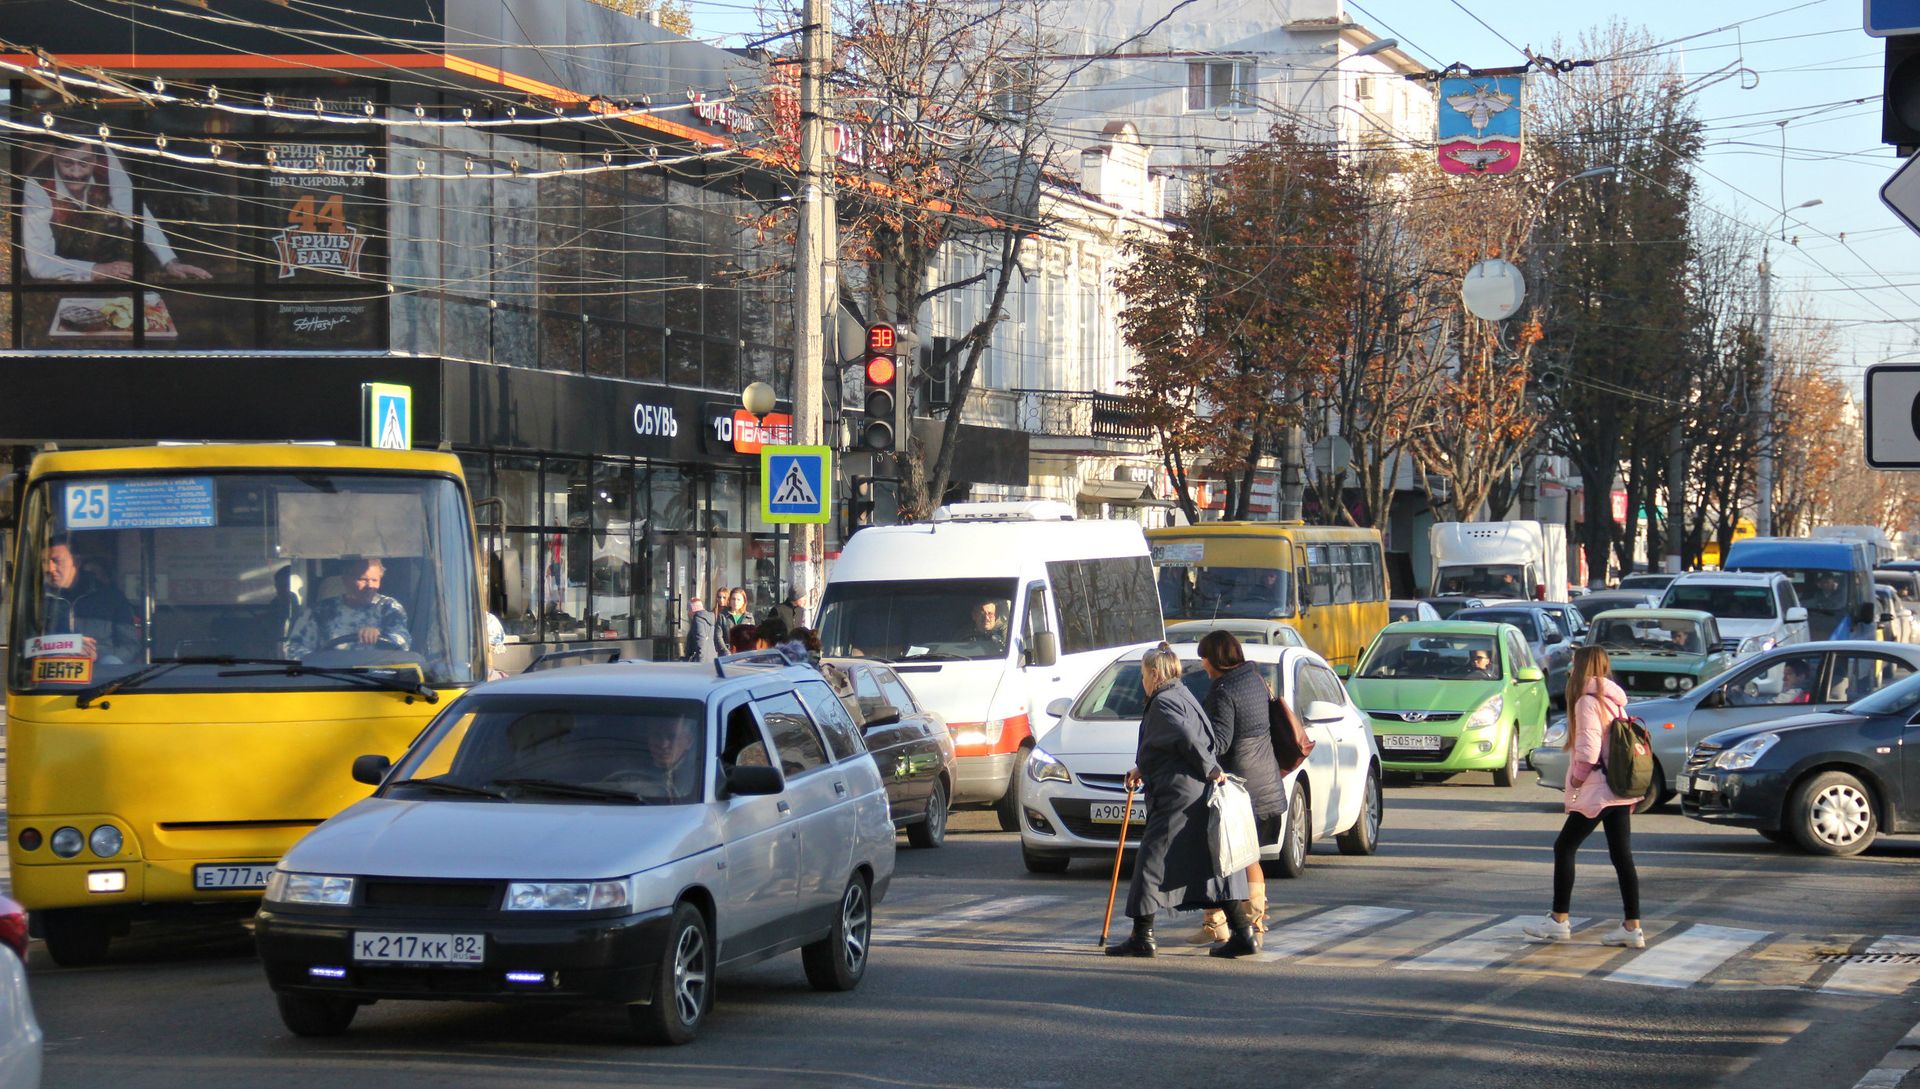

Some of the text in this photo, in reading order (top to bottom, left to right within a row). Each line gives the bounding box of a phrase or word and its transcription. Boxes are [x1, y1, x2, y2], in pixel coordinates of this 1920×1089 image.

[269, 145, 365, 158] ГРИЛЬ-БАР
[269, 160, 365, 173] ОТКРЫЛСЯ
[270, 177, 365, 189] ПР-Т КИРОВА, 24
[288, 195, 345, 233] 44
[291, 236, 349, 249] ГРИЛЬ
[297, 252, 342, 264] БАРА
[872, 329, 892, 346] 38
[634, 403, 678, 437] ОБУВЬ
[714, 417, 732, 442] 10
[72, 489, 104, 519] 25
[111, 516, 213, 528] АГРОУНИВЕРСИТЕТ
[38, 662, 84, 679] ЦЕНТР
[362, 936, 476, 959] К217КК 82
